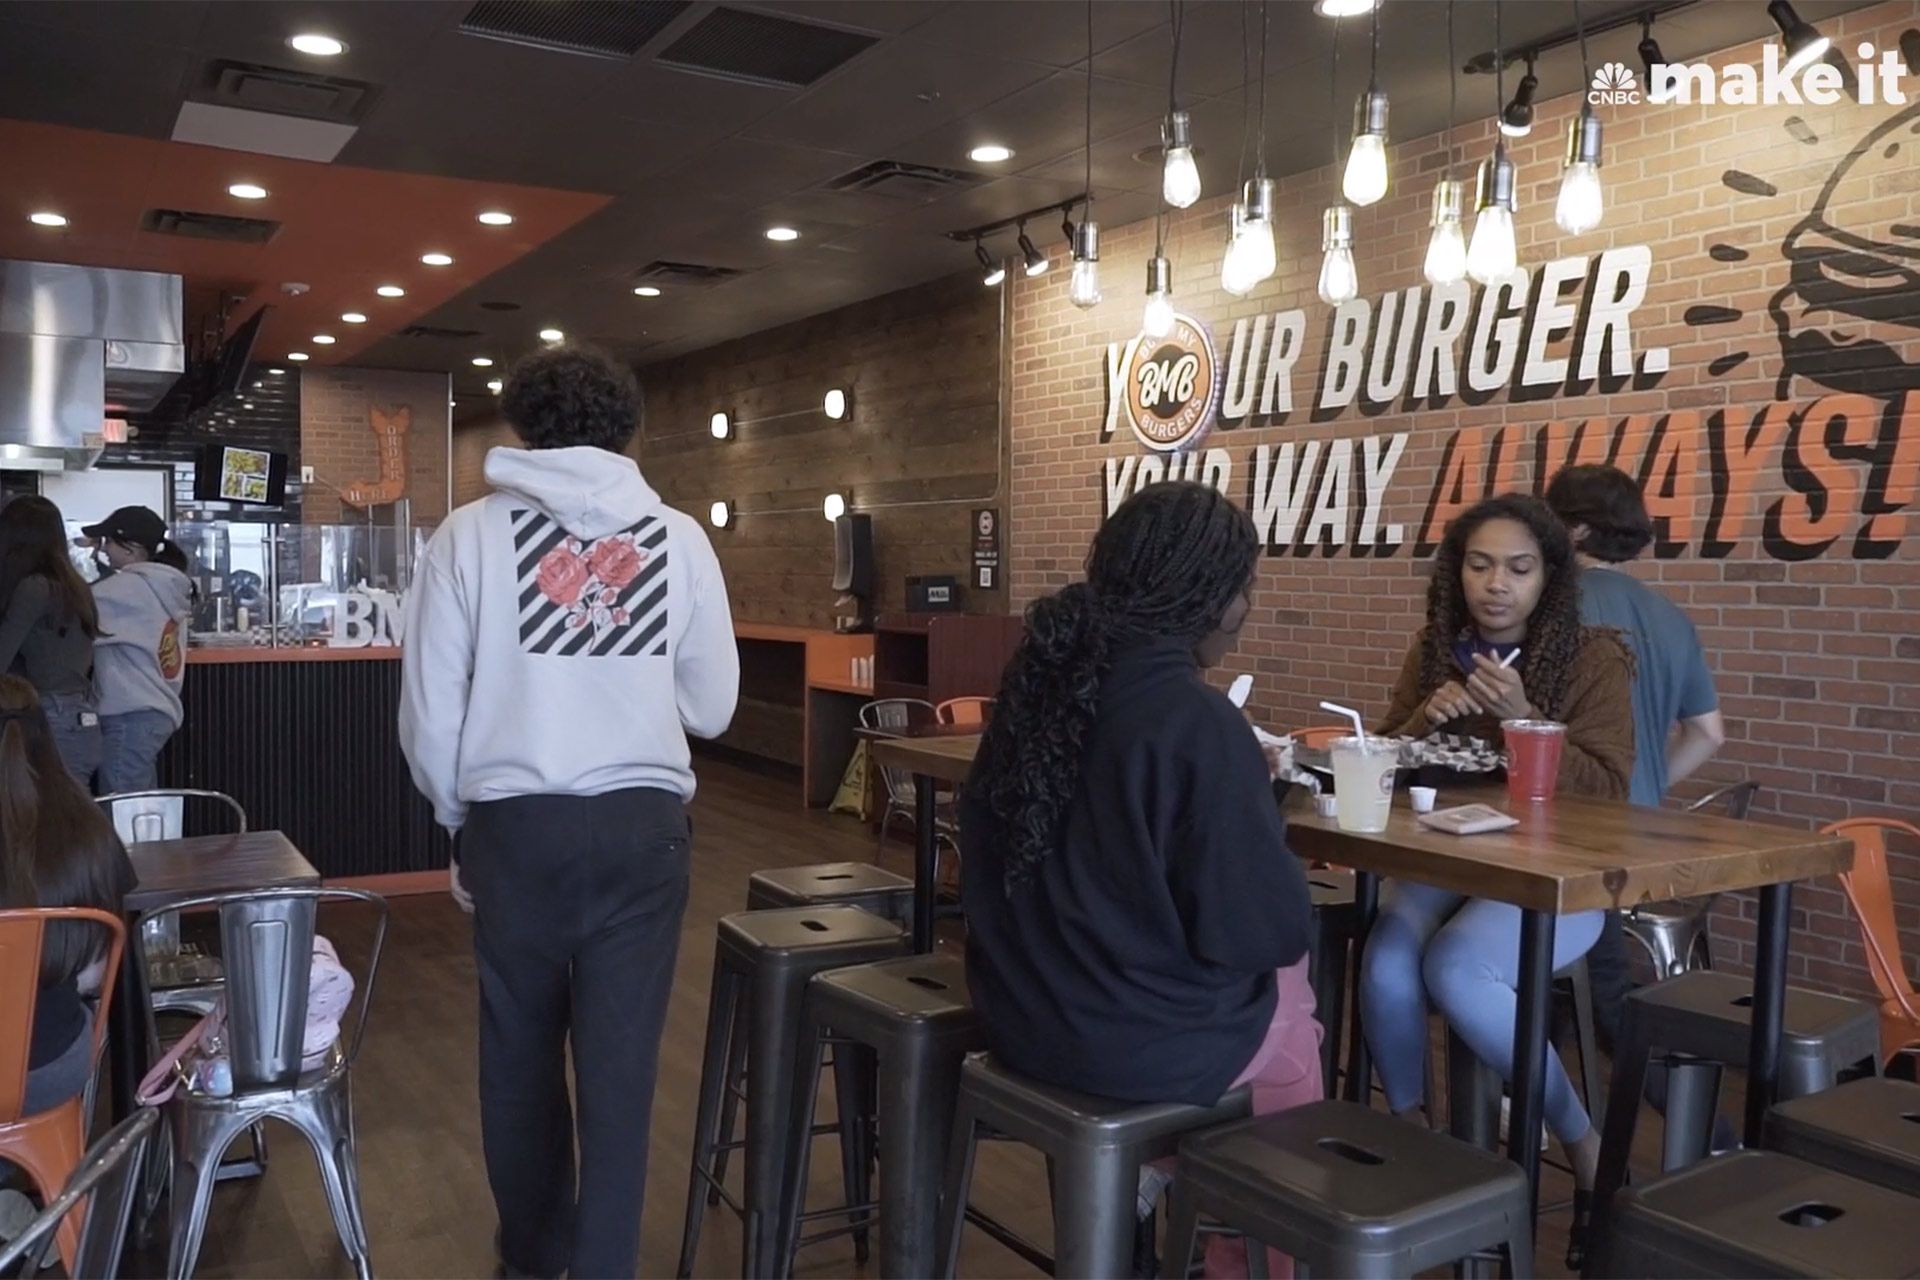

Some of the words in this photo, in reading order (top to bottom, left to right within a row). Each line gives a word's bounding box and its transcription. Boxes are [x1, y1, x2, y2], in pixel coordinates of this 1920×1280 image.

[1319, 244, 1670, 410] BURGER.
[1137, 354, 1200, 408] BMB
[1140, 397, 1202, 438] BURGERS
[387, 424, 401, 480] ORDER
[1252, 433, 1409, 546] WAY.
